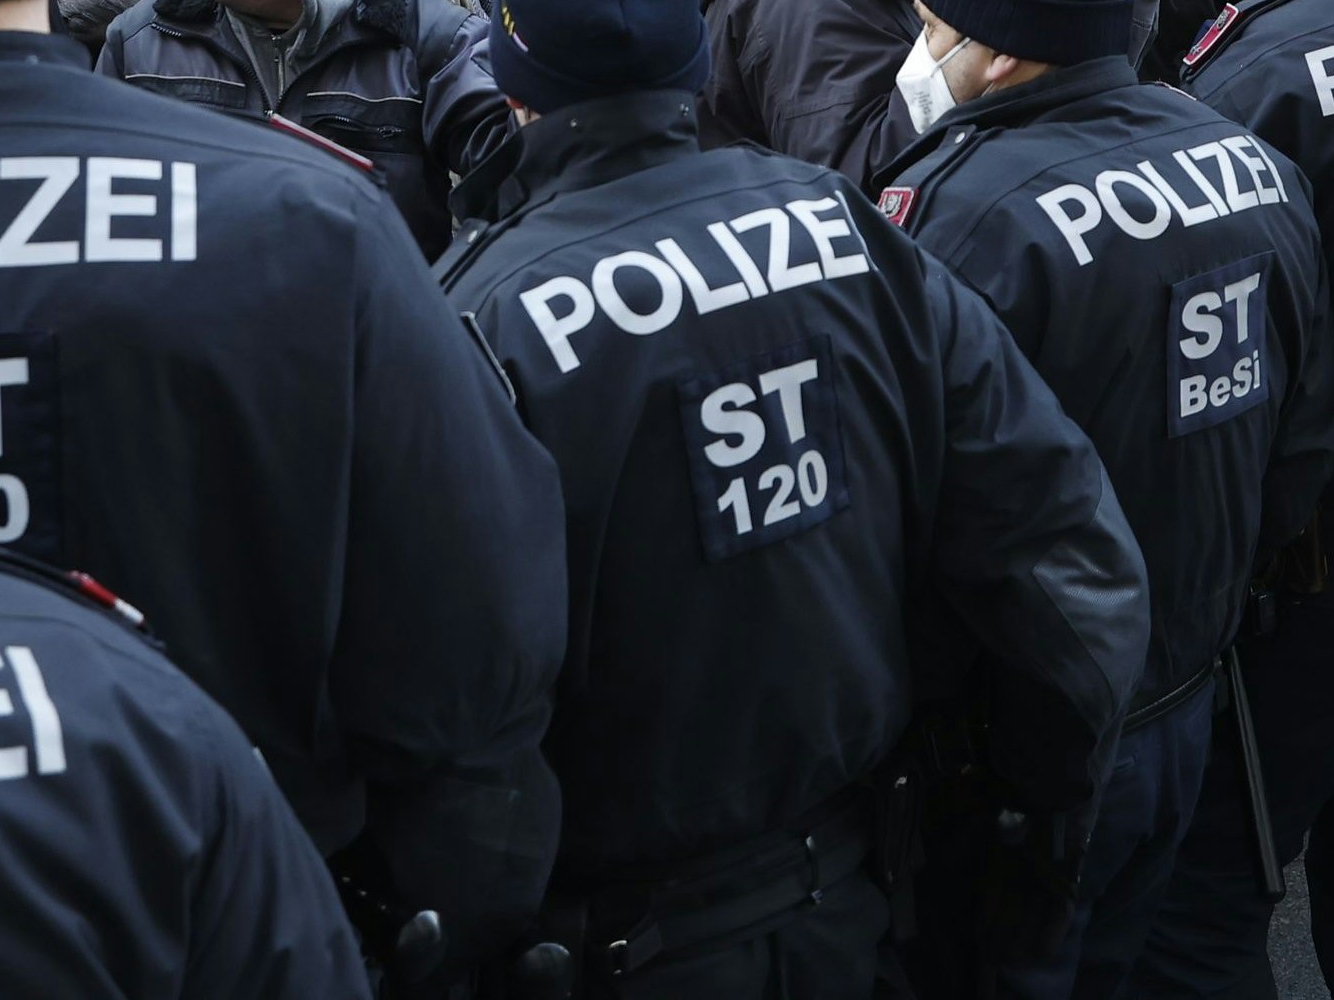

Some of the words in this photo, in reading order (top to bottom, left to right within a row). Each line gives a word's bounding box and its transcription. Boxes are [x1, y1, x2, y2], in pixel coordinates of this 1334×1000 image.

[1035, 134, 1289, 267] POLIZEI
[520, 187, 880, 374] POLIZE
[1179, 271, 1262, 361] ST
[700, 358, 819, 468] ST
[1179, 349, 1261, 419] BeSi
[716, 447, 827, 536] 120
